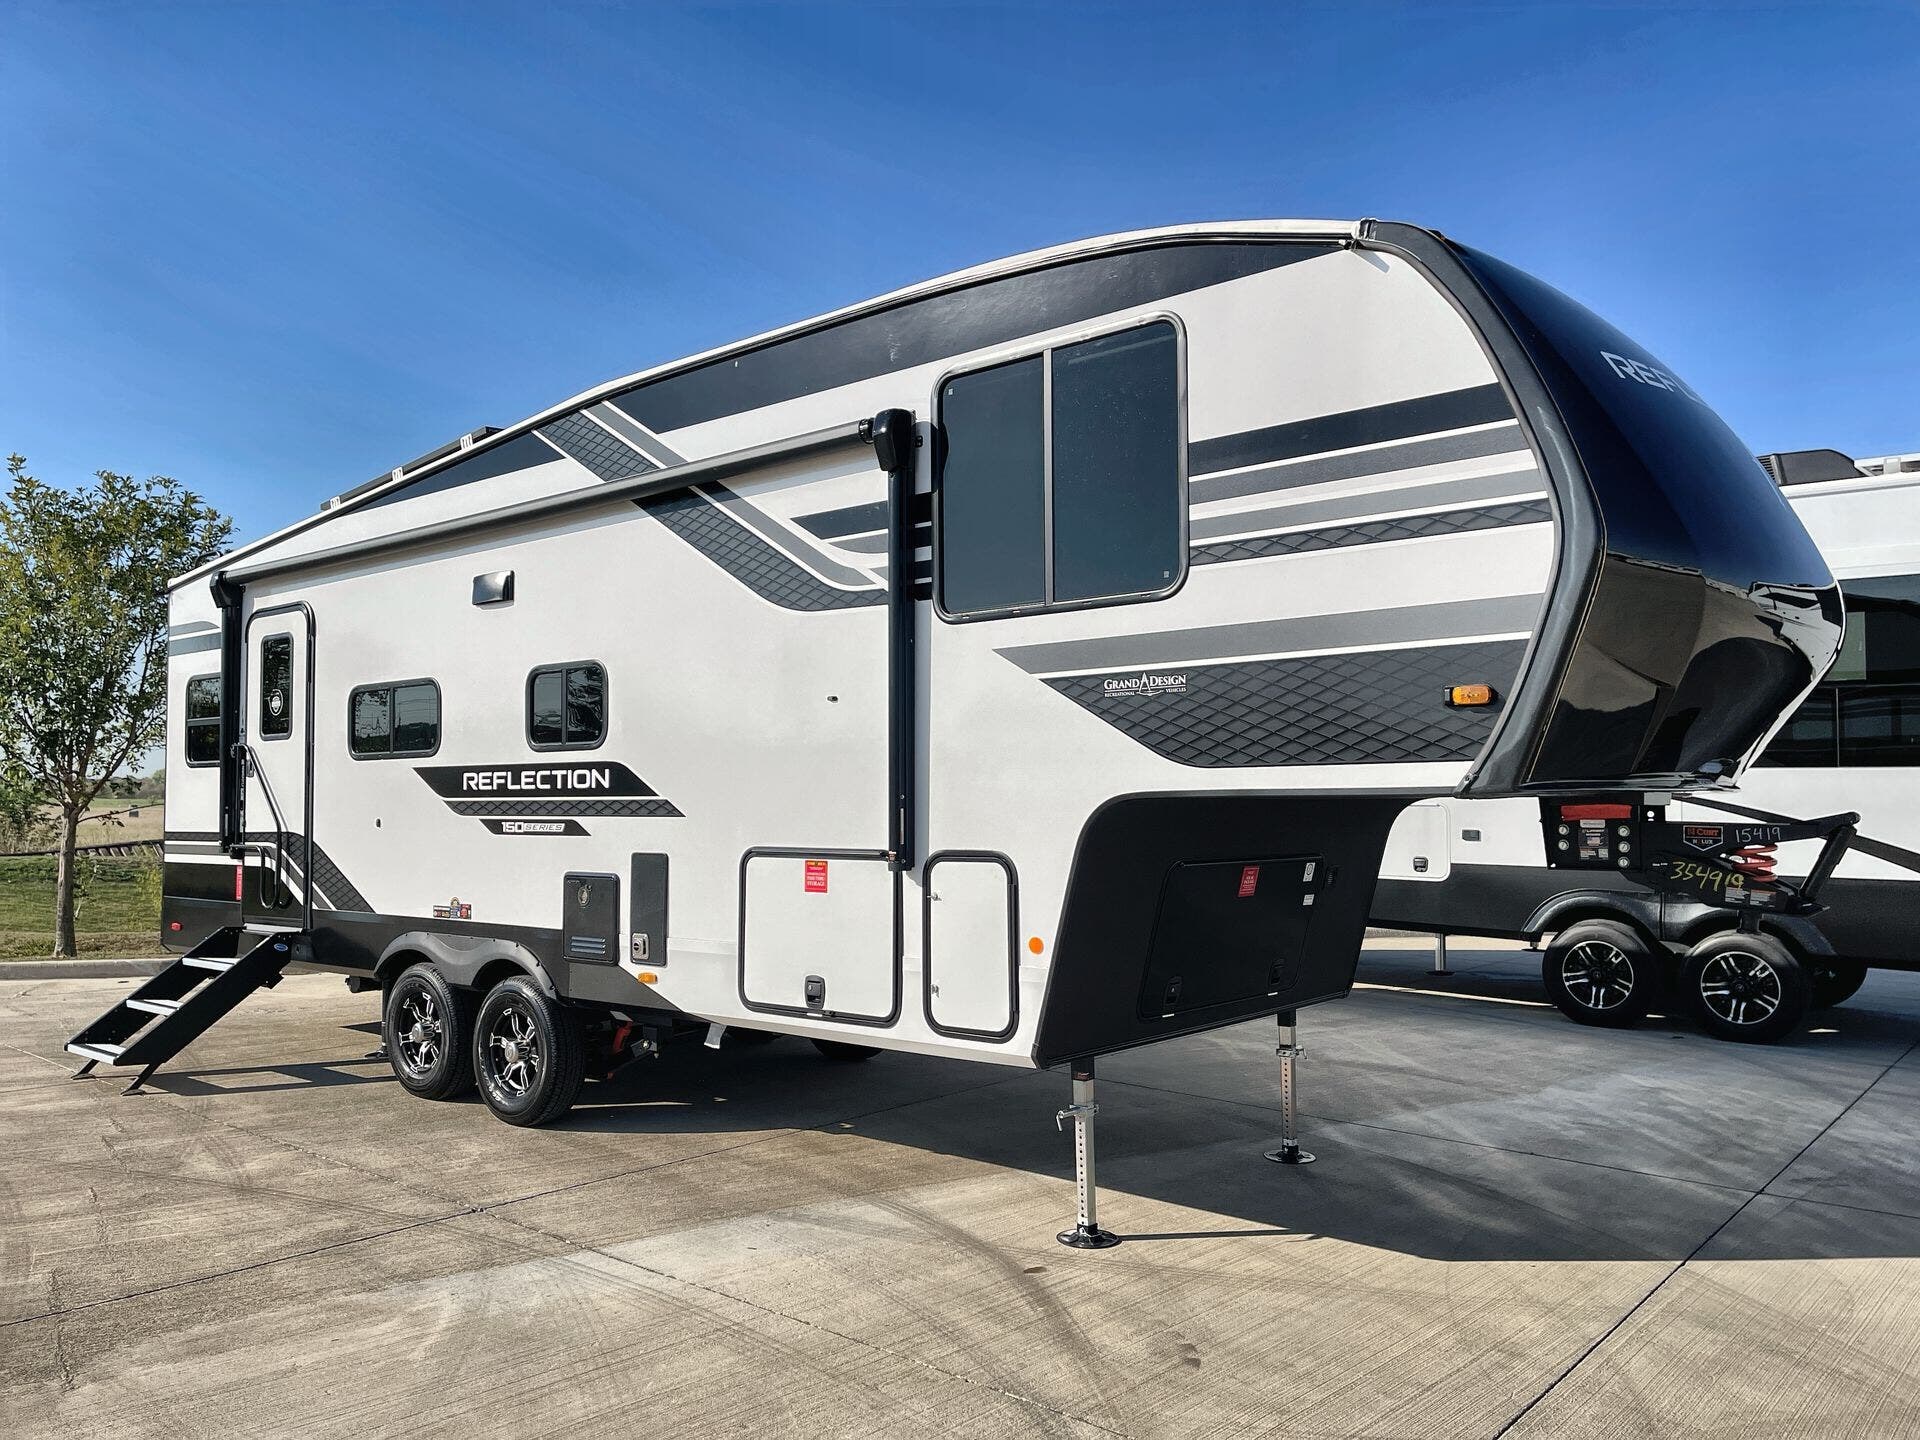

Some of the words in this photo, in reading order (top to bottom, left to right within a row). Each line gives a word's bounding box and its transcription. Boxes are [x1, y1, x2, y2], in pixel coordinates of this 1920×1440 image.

[1103, 679, 1140, 690] GRAND
[1149, 673, 1188, 687] DESIGN
[462, 768, 610, 791] REFLECTION
[501, 821, 525, 833] 150
[525, 823, 565, 833] SERIES
[1735, 826, 1781, 843] 15419
